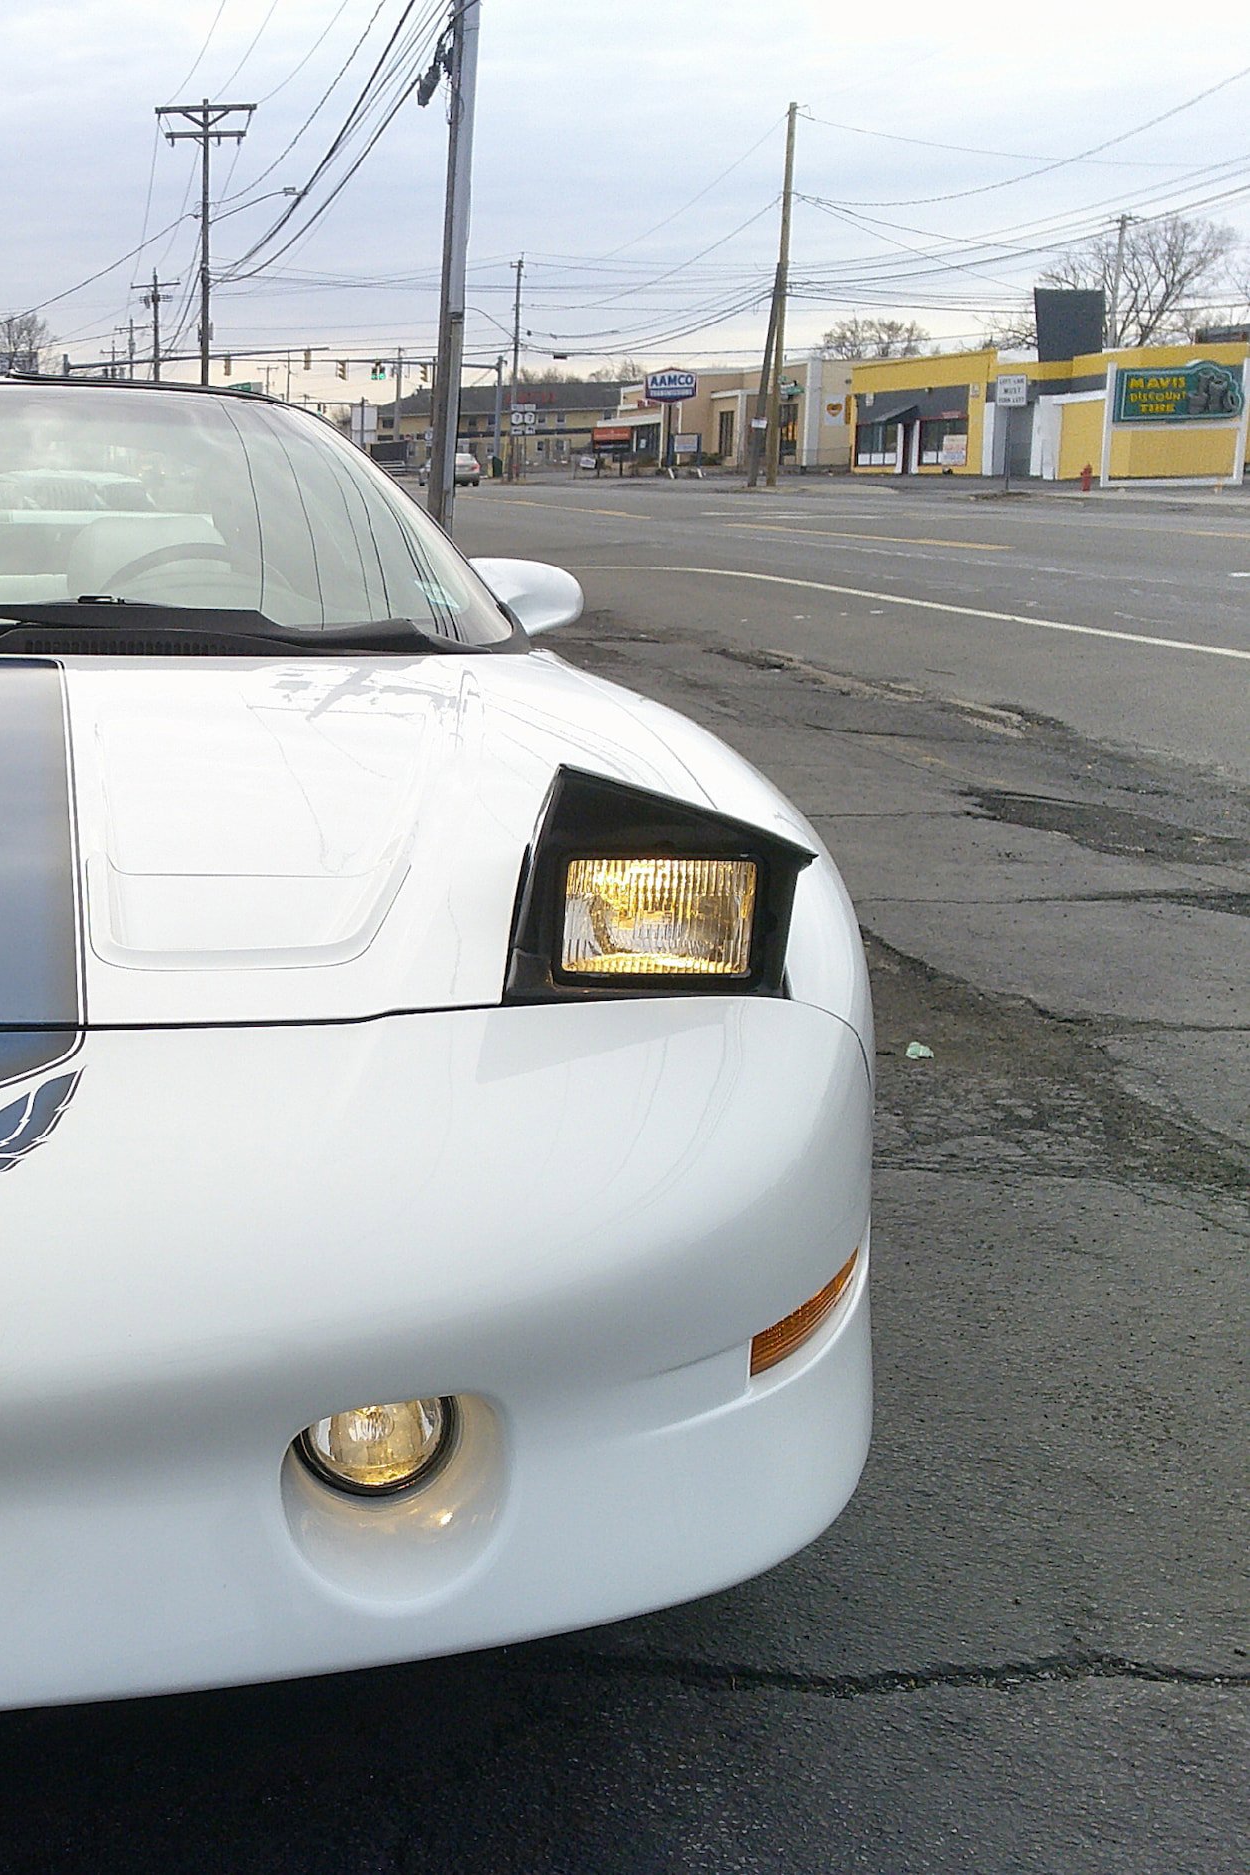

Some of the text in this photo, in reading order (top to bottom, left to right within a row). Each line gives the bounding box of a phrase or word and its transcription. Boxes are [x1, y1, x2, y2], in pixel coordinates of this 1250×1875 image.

[650, 374, 694, 387] AAMCO
[1129, 377, 1186, 389] MAVIS
[1139, 403, 1175, 413] TIRE
